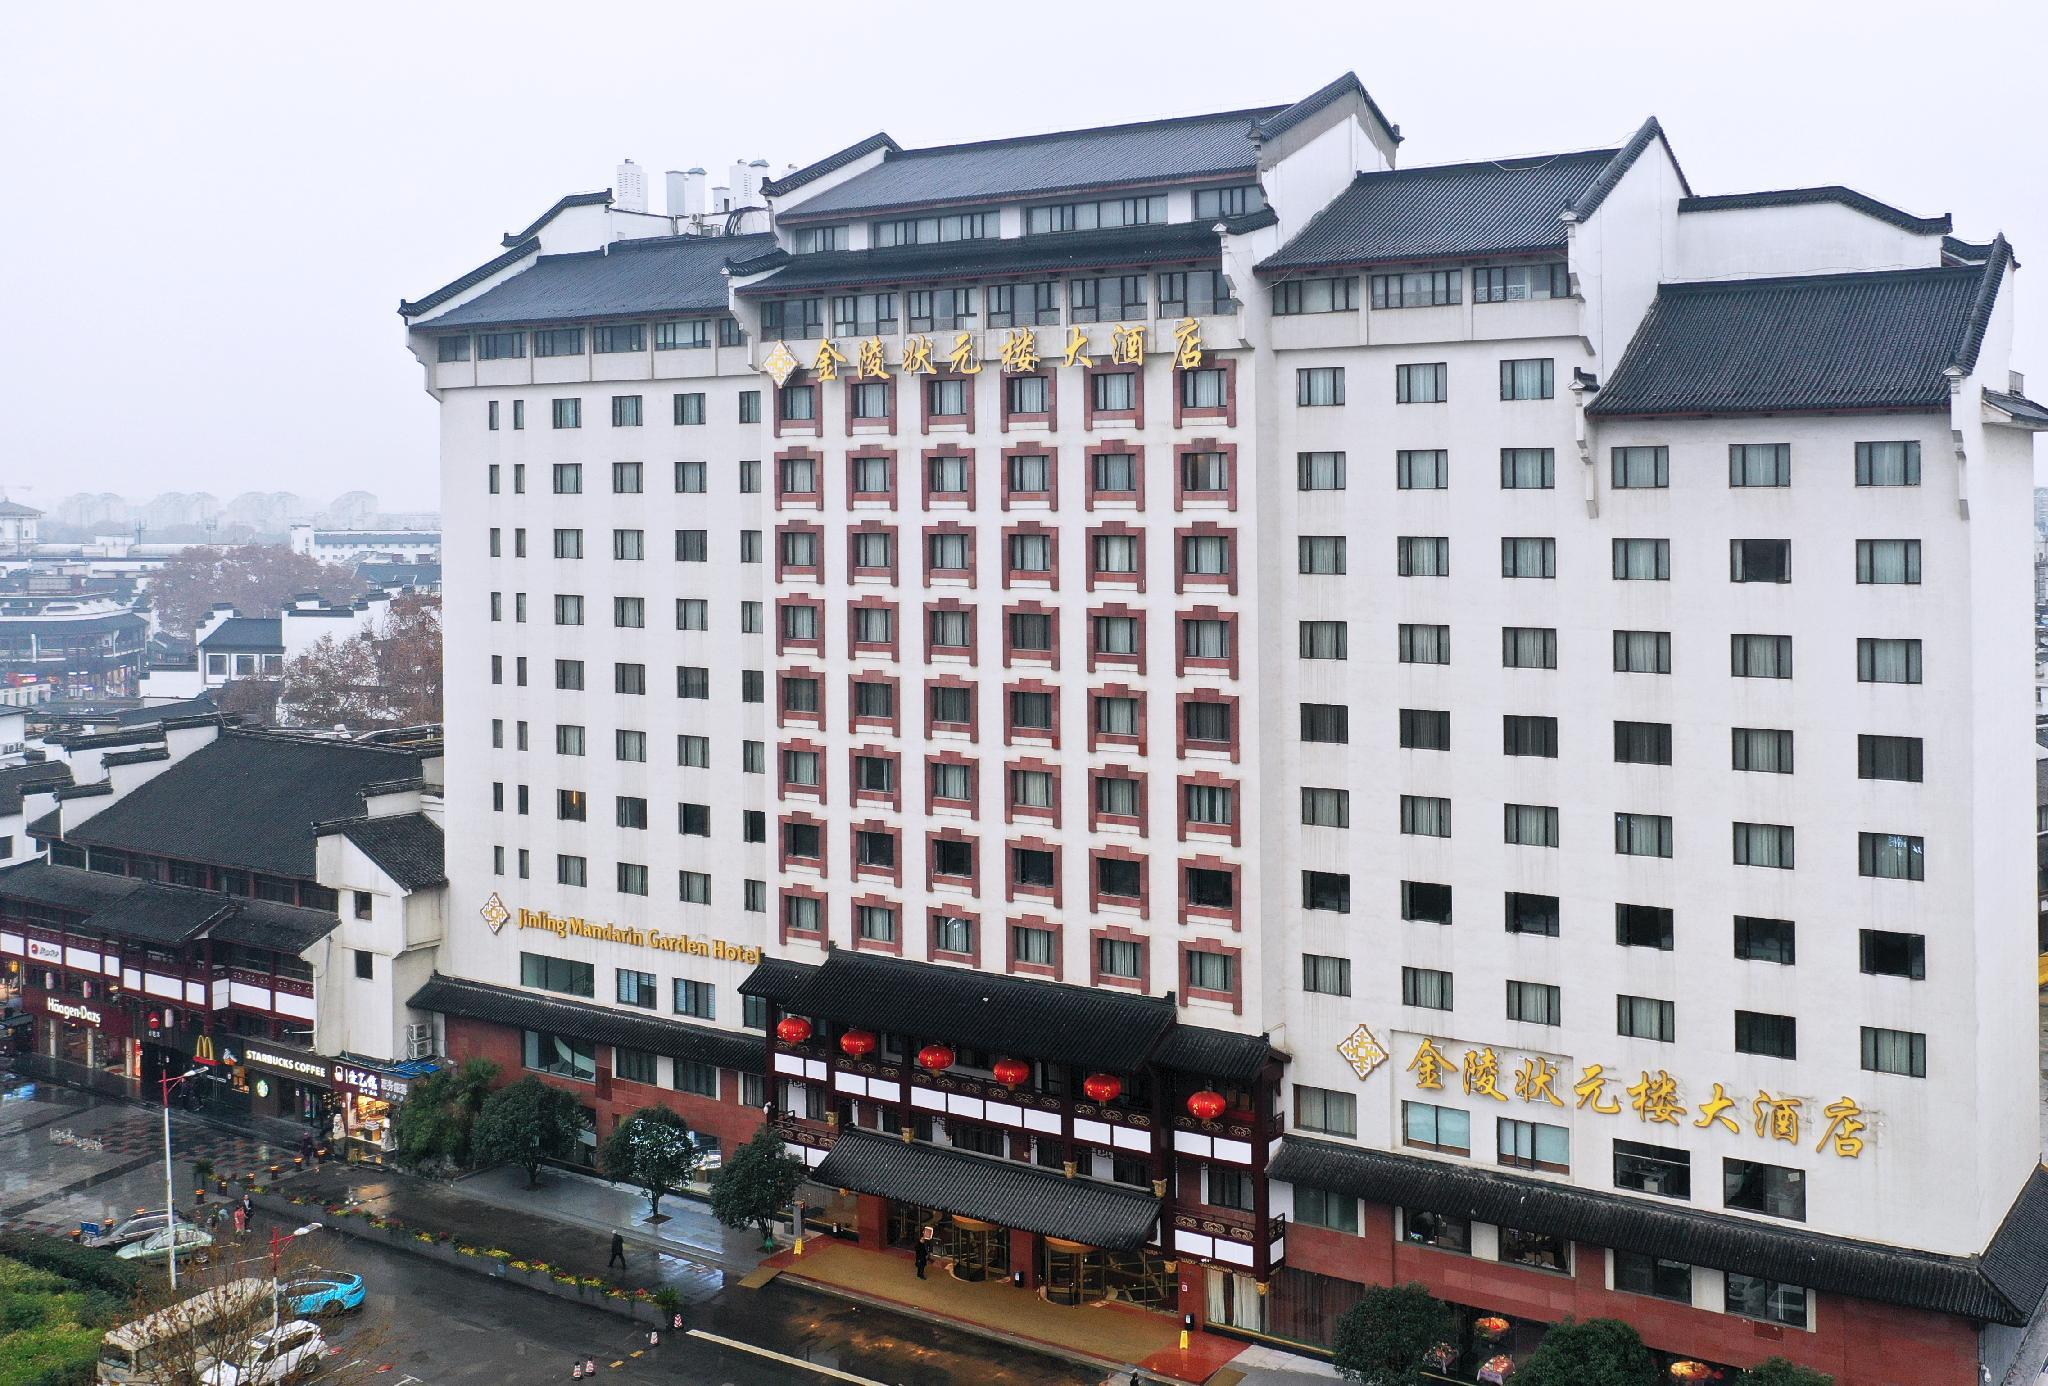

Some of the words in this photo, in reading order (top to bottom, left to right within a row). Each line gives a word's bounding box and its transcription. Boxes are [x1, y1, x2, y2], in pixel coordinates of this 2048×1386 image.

[811, 317, 1203, 382] 金陵状元楼大酒店
[519, 908, 566, 938] Jinling
[569, 917, 644, 946] Mandarin
[648, 929, 709, 957] Garden
[712, 939, 763, 965] Hotel
[47, 997, 101, 1023] Häagen-Dazs
[246, 1049, 294, 1070] STARBUCKS
[294, 1061, 326, 1078] COFFEE
[1407, 1038, 1864, 1159] 金陵状元楼大酒店
